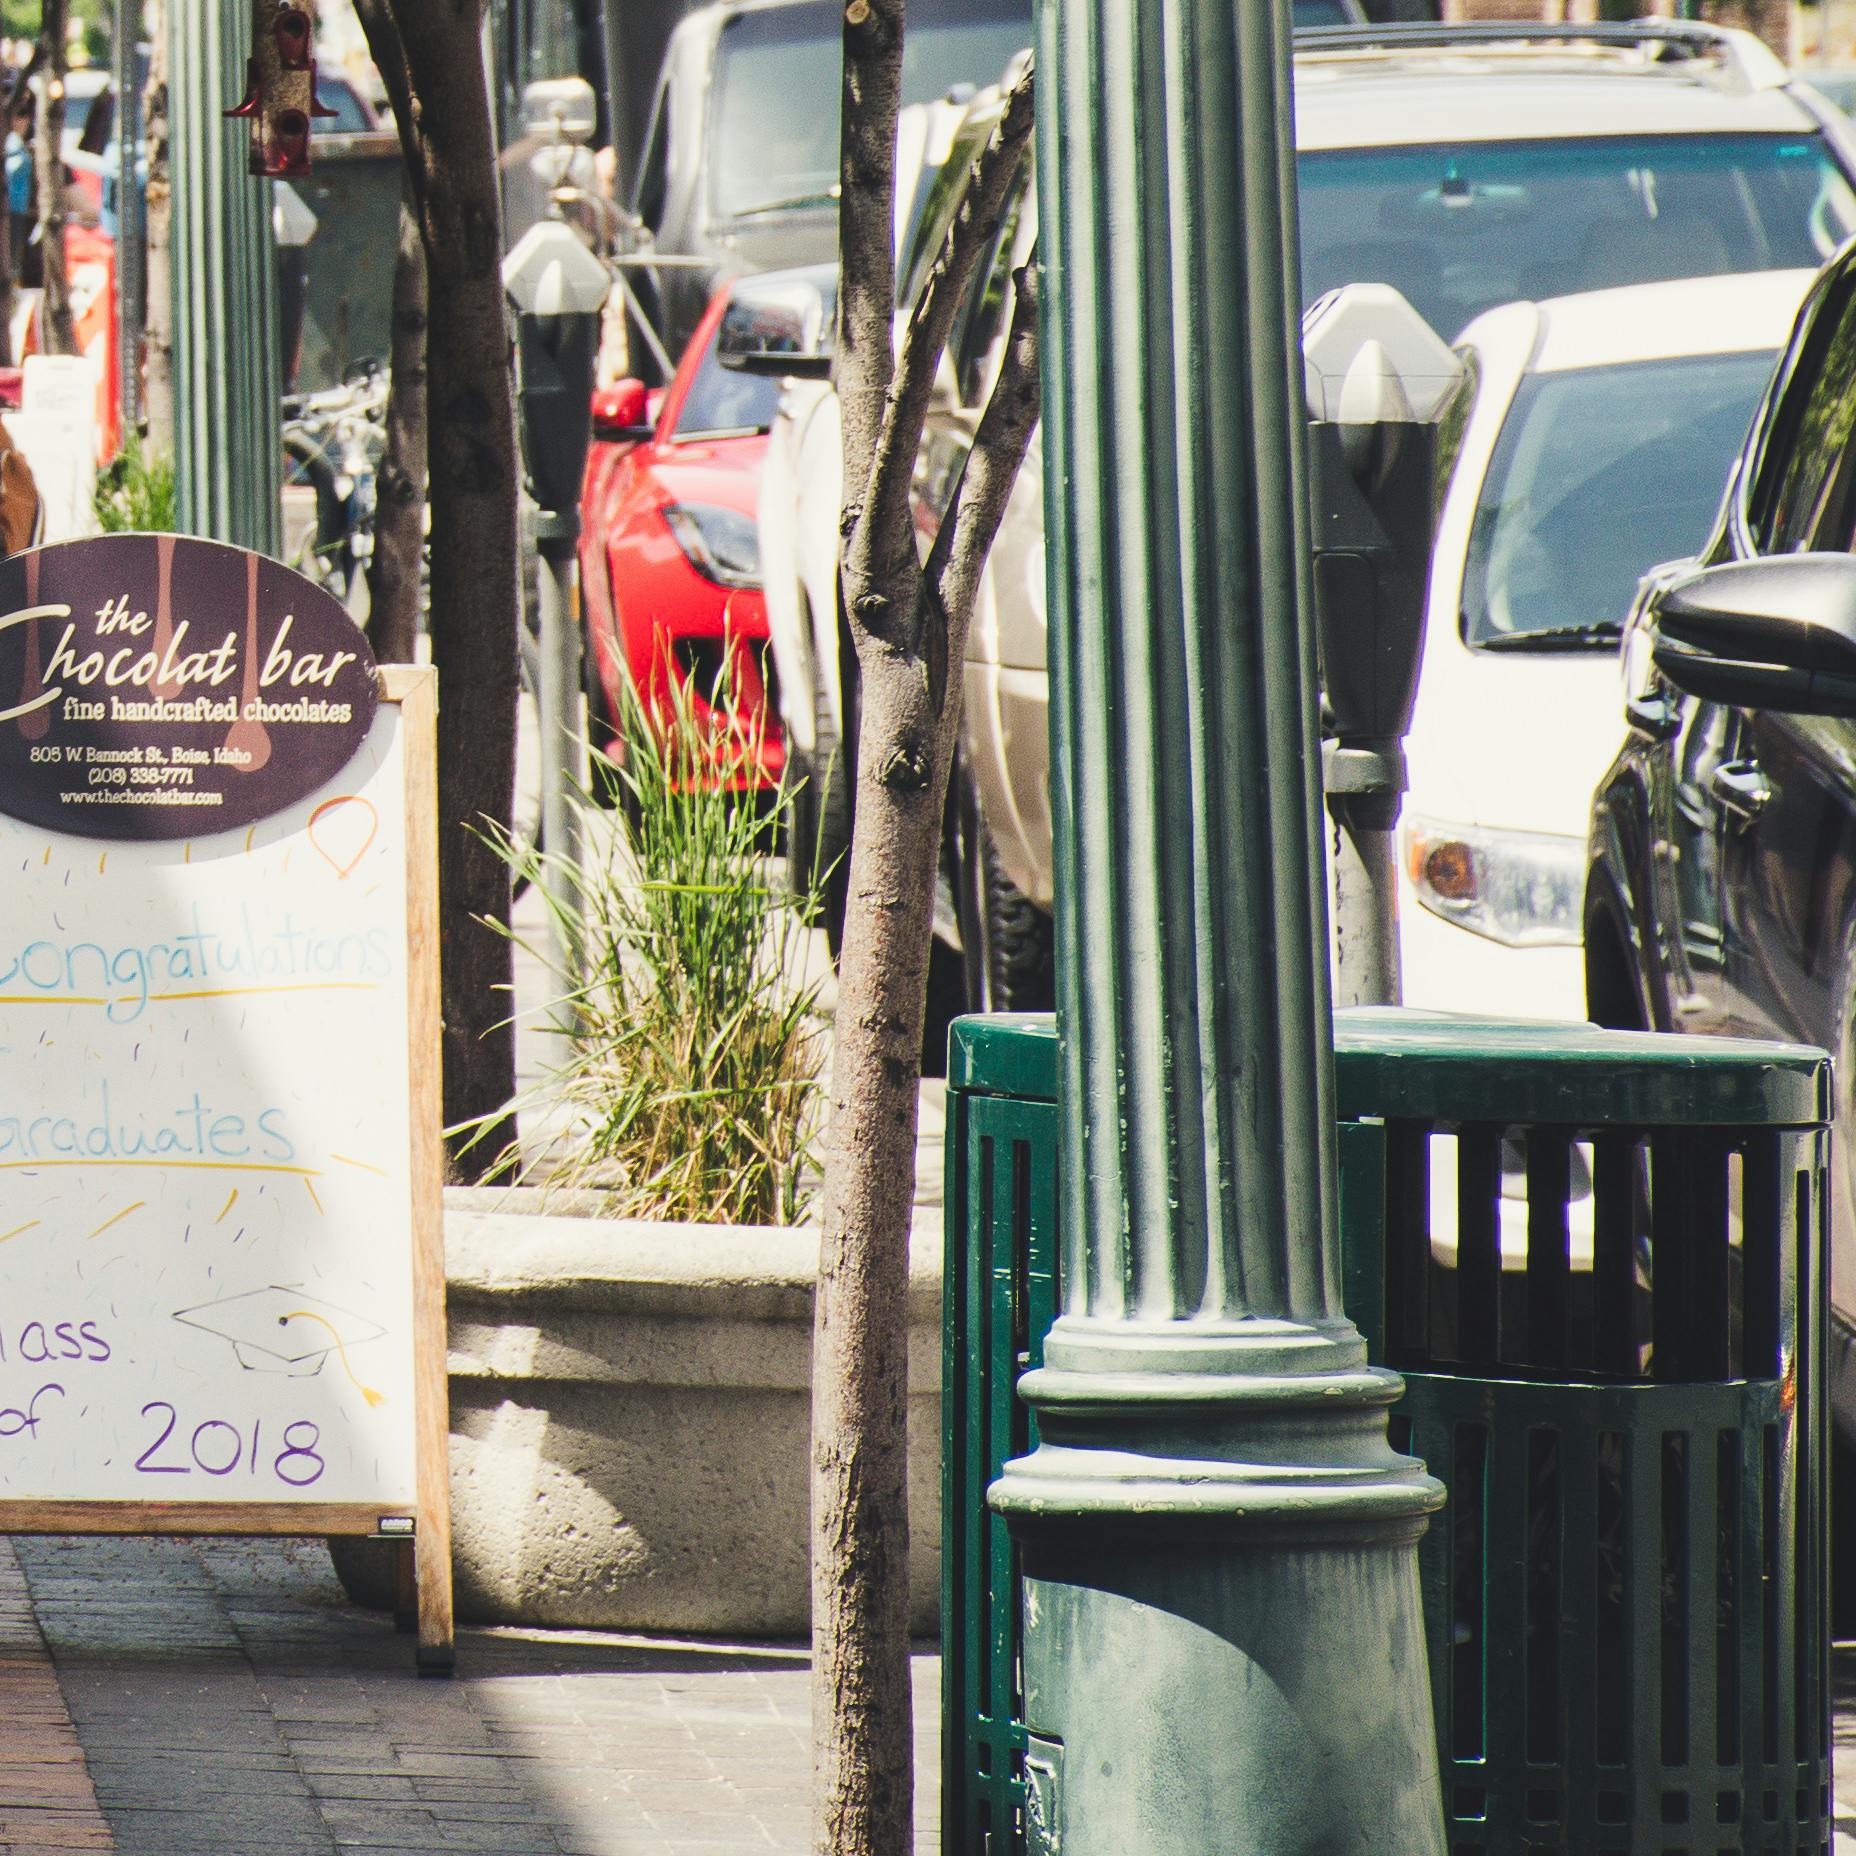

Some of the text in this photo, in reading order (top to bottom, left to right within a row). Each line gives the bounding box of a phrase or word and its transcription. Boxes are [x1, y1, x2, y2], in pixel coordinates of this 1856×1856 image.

[94, 593, 153, 636] the
[259, 614, 358, 688] bar
[63, 693, 352, 724] fine handcrafted chocolates
[30, 746, 61, 763] 805
[85, 746, 143, 764] Bannock
[172, 747, 211, 766] Boise,
[214, 747, 252, 765] Idaho
[88, 767, 194, 785] (208) 338-7771
[60, 788, 224, 806] www.thechocolatbar.com
[134, 1401, 325, 1486] 2018
